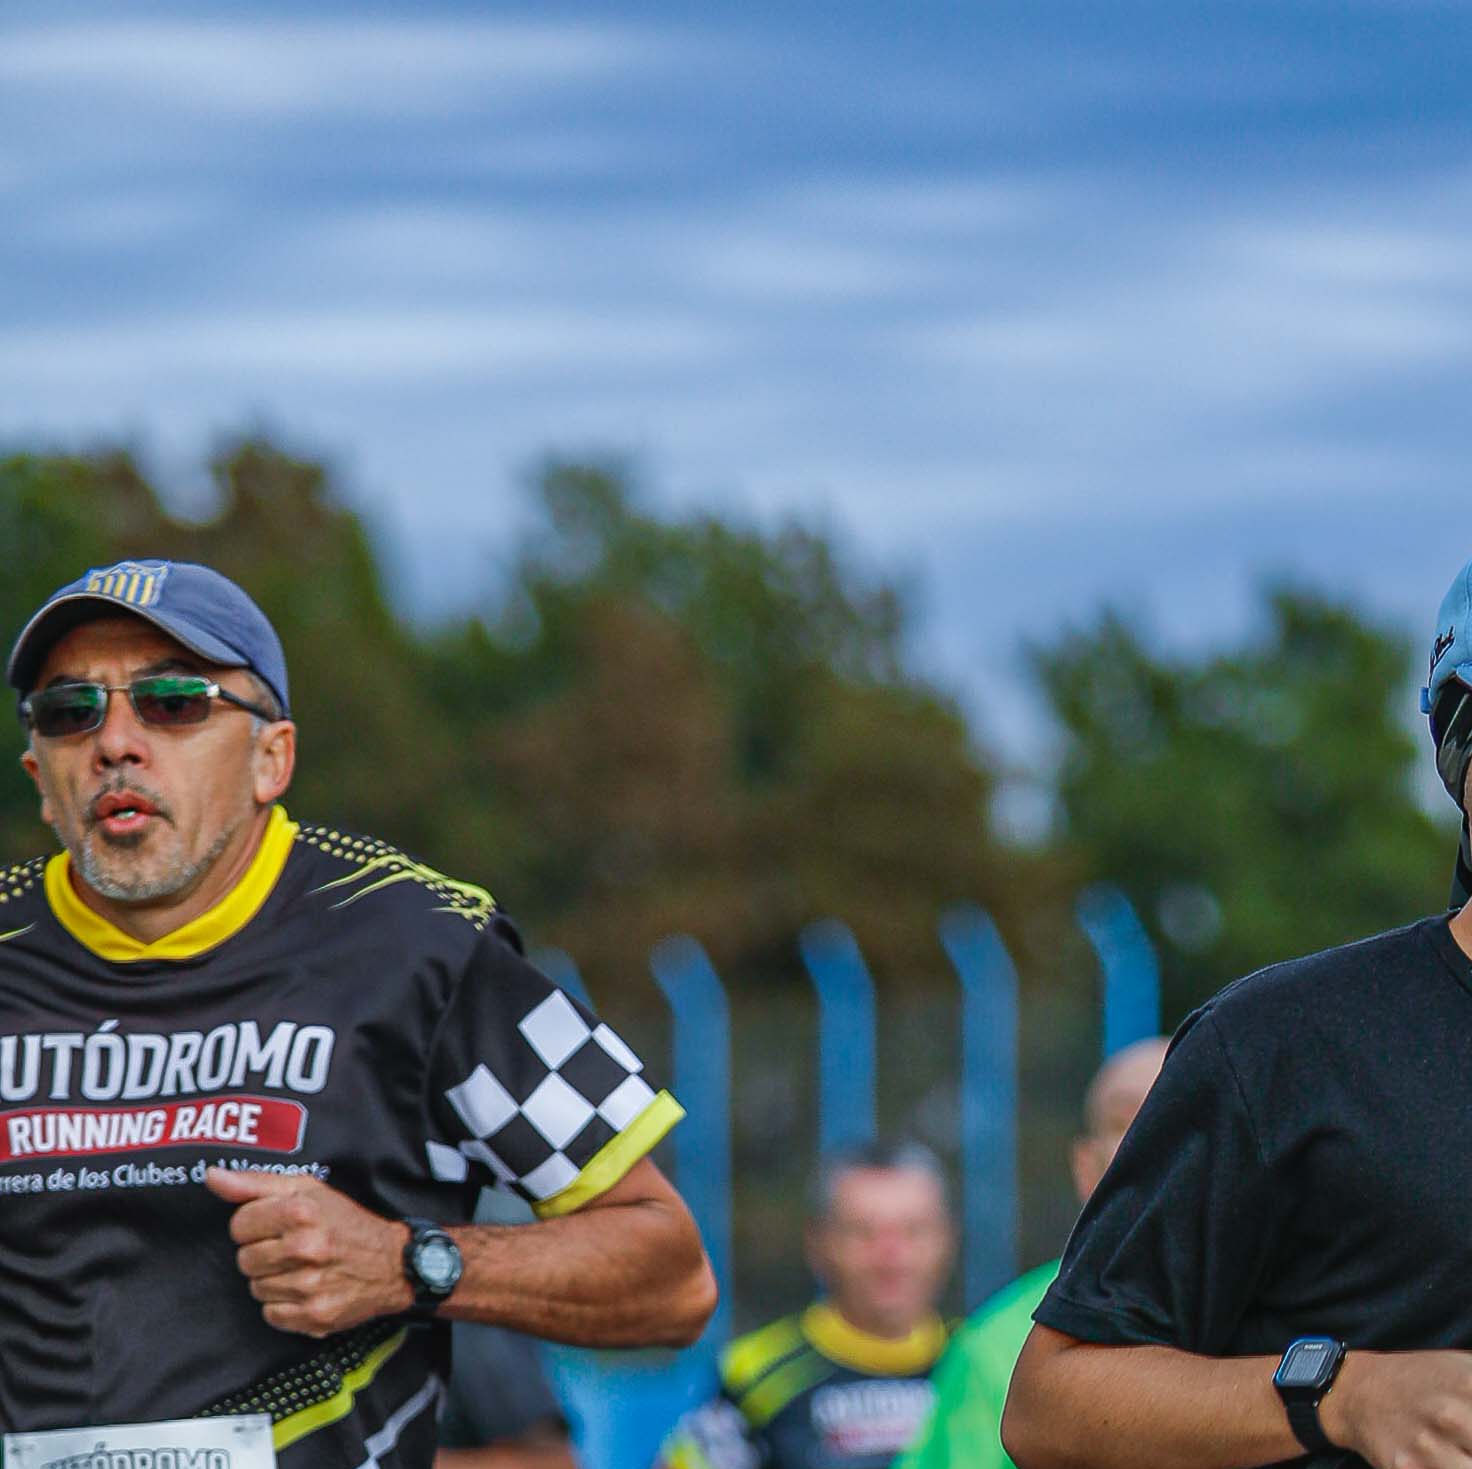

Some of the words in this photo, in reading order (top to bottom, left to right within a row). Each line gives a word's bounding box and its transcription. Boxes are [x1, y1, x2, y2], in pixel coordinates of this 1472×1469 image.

[0, 1019, 336, 1101] UTÓDROMO
[8, 1109, 166, 1156] RUNNING
[169, 1102, 262, 1144] RACE
[0, 1173, 44, 1194] rrera
[46, 1167, 76, 1191] de
[77, 1166, 111, 1189] los
[112, 1162, 188, 1187] Clubes
